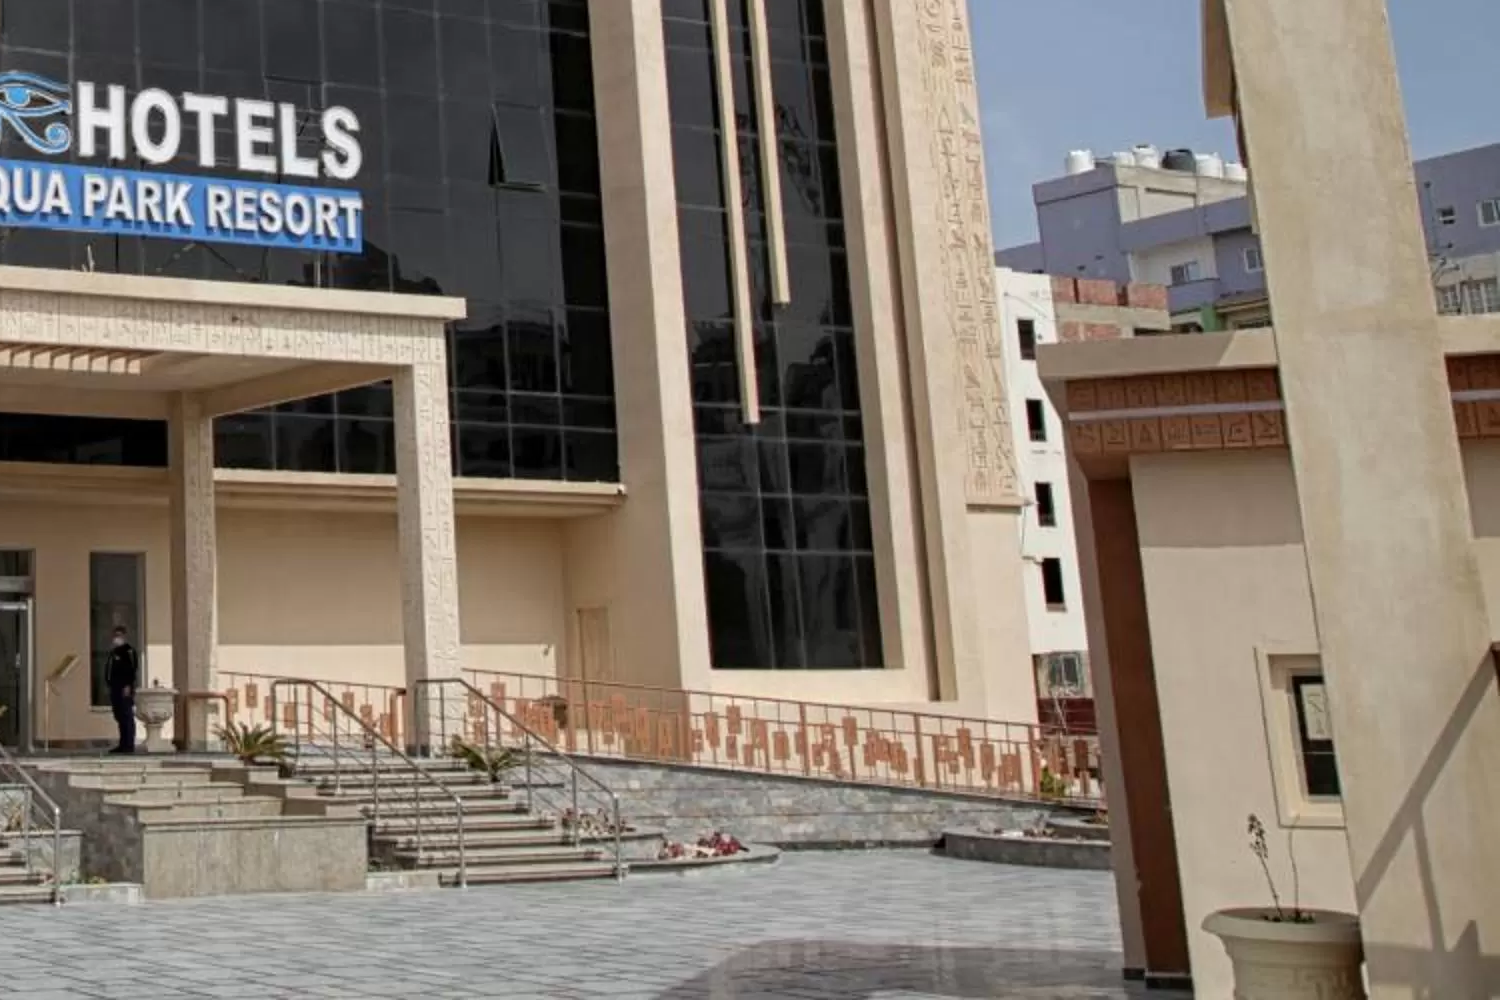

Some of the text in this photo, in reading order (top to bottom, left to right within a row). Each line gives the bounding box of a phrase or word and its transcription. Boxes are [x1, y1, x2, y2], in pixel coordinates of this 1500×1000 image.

[77, 81, 362, 179] HOTELS
[83, 173, 194, 226] PARK
[207, 184, 363, 239] RESORT
